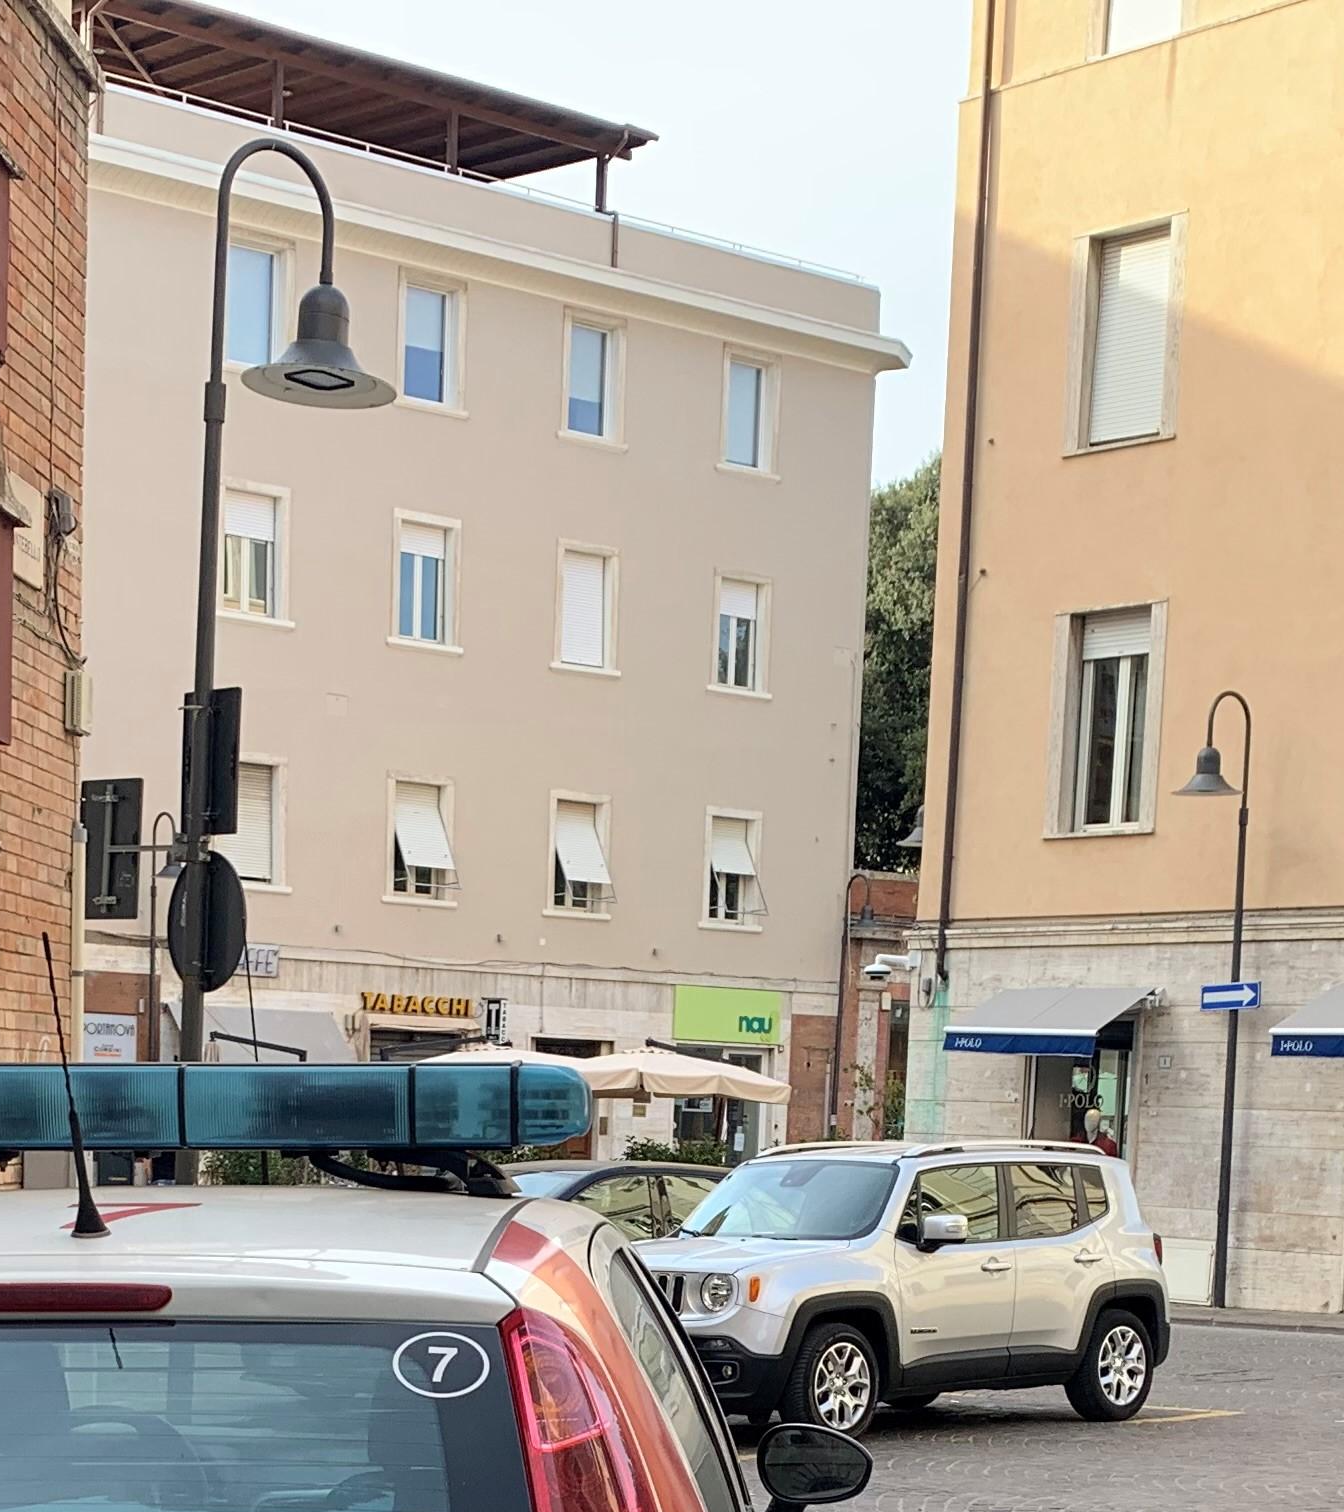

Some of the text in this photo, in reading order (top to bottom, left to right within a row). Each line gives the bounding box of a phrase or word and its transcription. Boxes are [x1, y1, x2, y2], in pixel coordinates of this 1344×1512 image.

[361, 992, 476, 1017] TABACCHI
[738, 1015, 773, 1034] nau
[426, 1346, 459, 1384] 7
